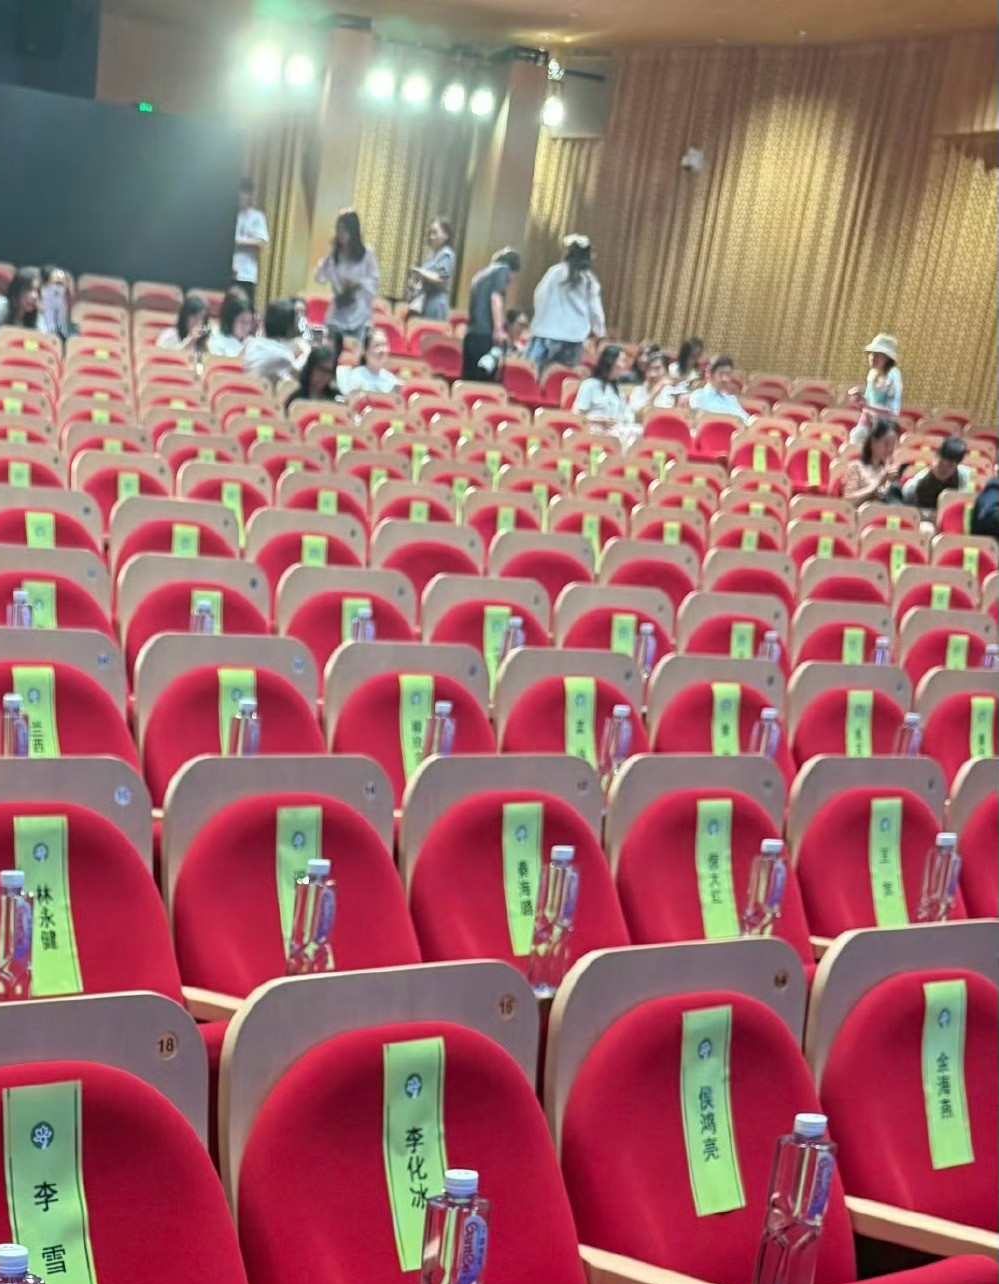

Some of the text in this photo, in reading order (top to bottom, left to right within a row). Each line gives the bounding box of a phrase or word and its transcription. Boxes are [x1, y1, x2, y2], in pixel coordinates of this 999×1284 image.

[157, 1038, 175, 1053] 18
[699, 1085, 720, 1163] 侯鸿亮
[405, 1126, 428, 1210] 李化冰
[33, 1180, 67, 1275] 李雪
